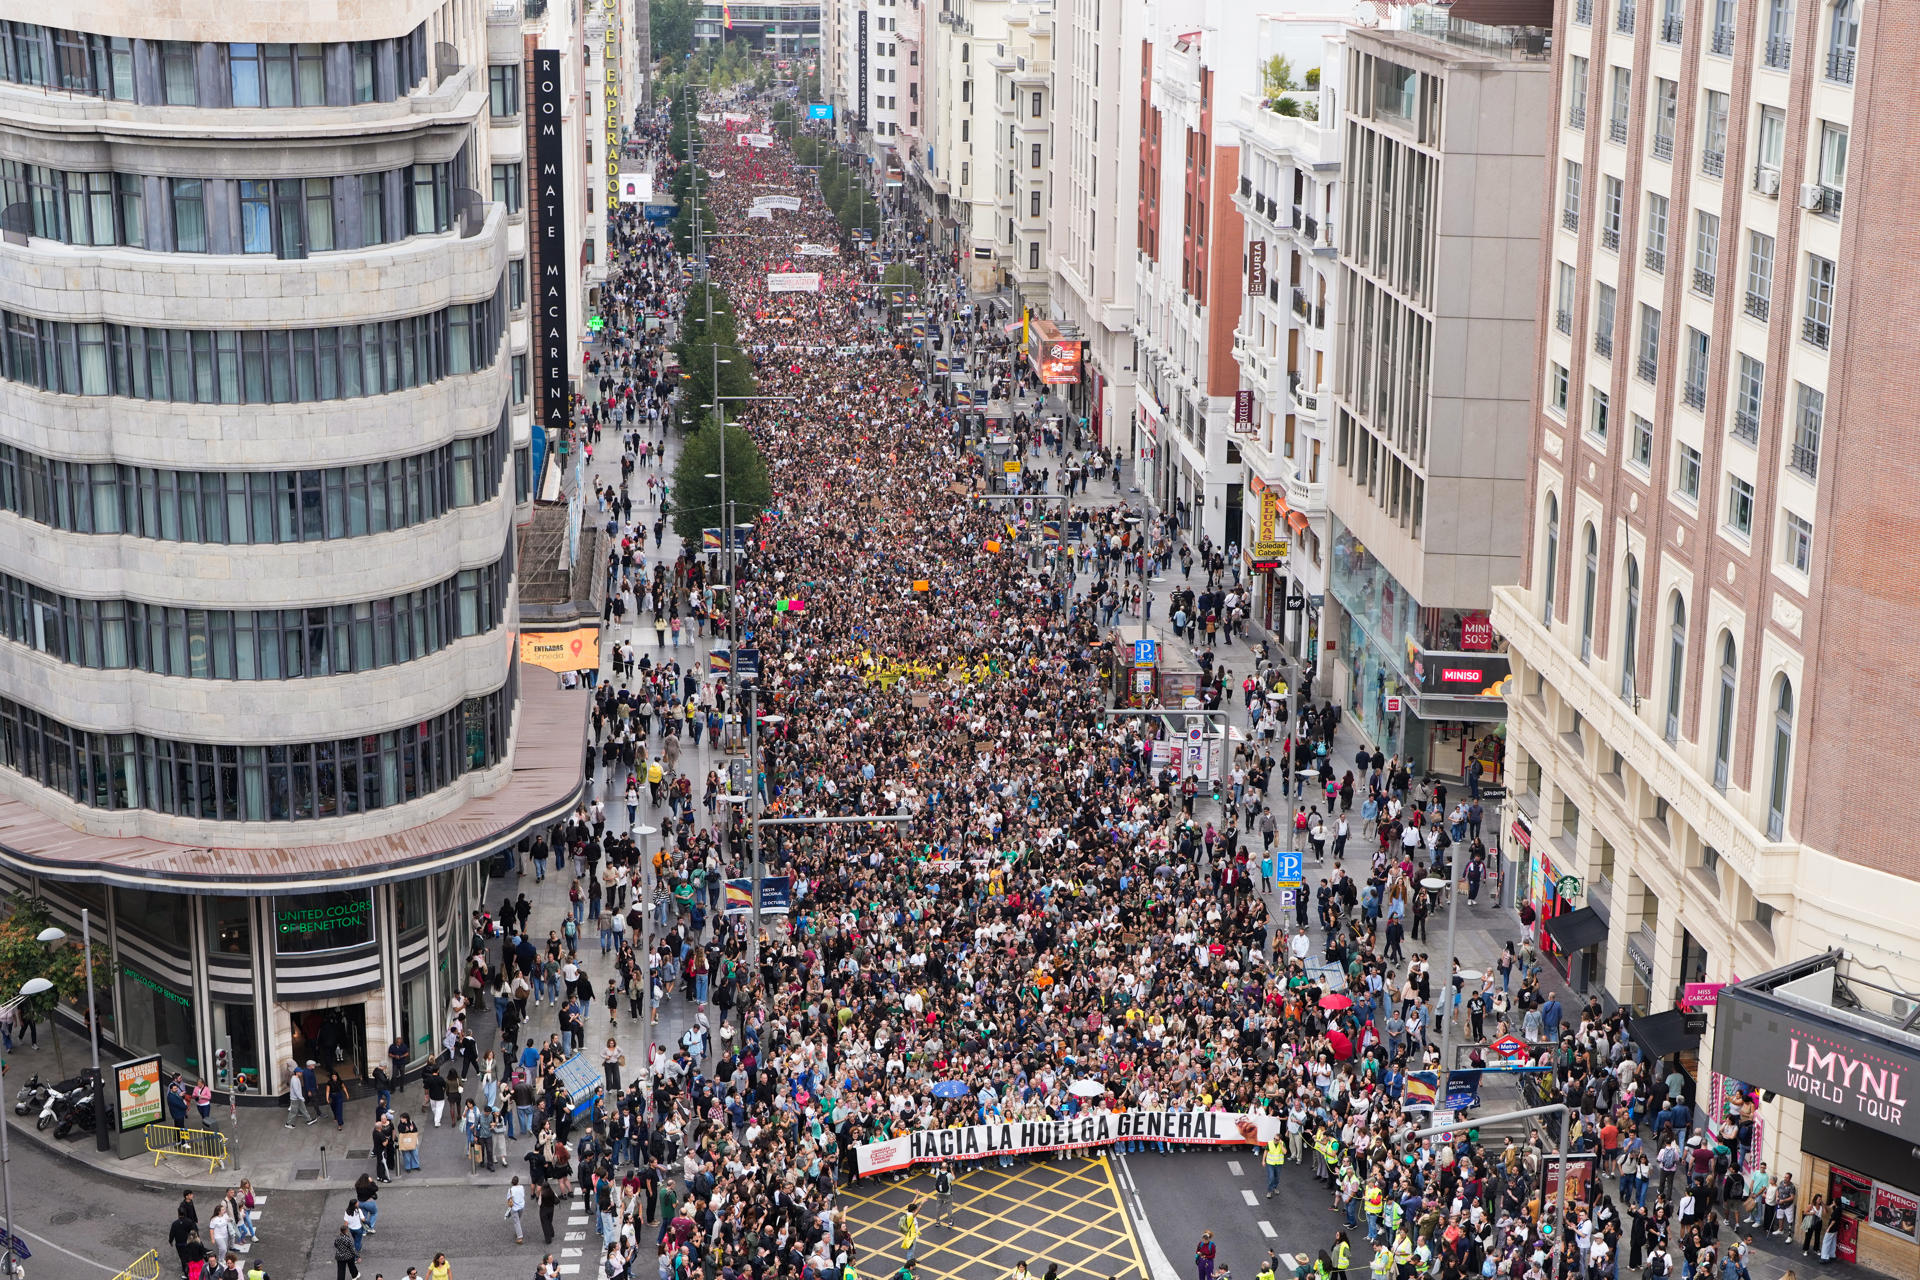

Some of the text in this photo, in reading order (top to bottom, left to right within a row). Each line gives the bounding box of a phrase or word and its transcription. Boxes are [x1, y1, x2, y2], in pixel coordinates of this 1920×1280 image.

[606, 69, 619, 209] EMPERADOR
[542, 60, 561, 419] ROOM MATE MACARENA
[1240, 392, 1248, 423] EXCELSIOR
[1263, 493, 1274, 541] PELUCAS
[1465, 624, 1489, 633] MINI
[1139, 643, 1151, 660] P
[1445, 671, 1479, 681] MINISO
[1282, 856, 1298, 877] P
[278, 900, 372, 920] UNITED COLORS
[280, 923, 297, 933] OF
[1788, 1038, 1907, 1107] LMYNL
[1787, 1070, 1902, 1126] WORLD TOUR
[911, 1126, 979, 1158] HACIA
[987, 1124, 1012, 1151] LA
[1021, 1115, 1109, 1148] HUELGA
[1117, 1112, 1221, 1139] GENERAL
[961, 1152, 993, 1160] ALQUILER
[1549, 1162, 1586, 1170] poeyes
[1878, 1190, 1917, 1208] FLAMENCO
